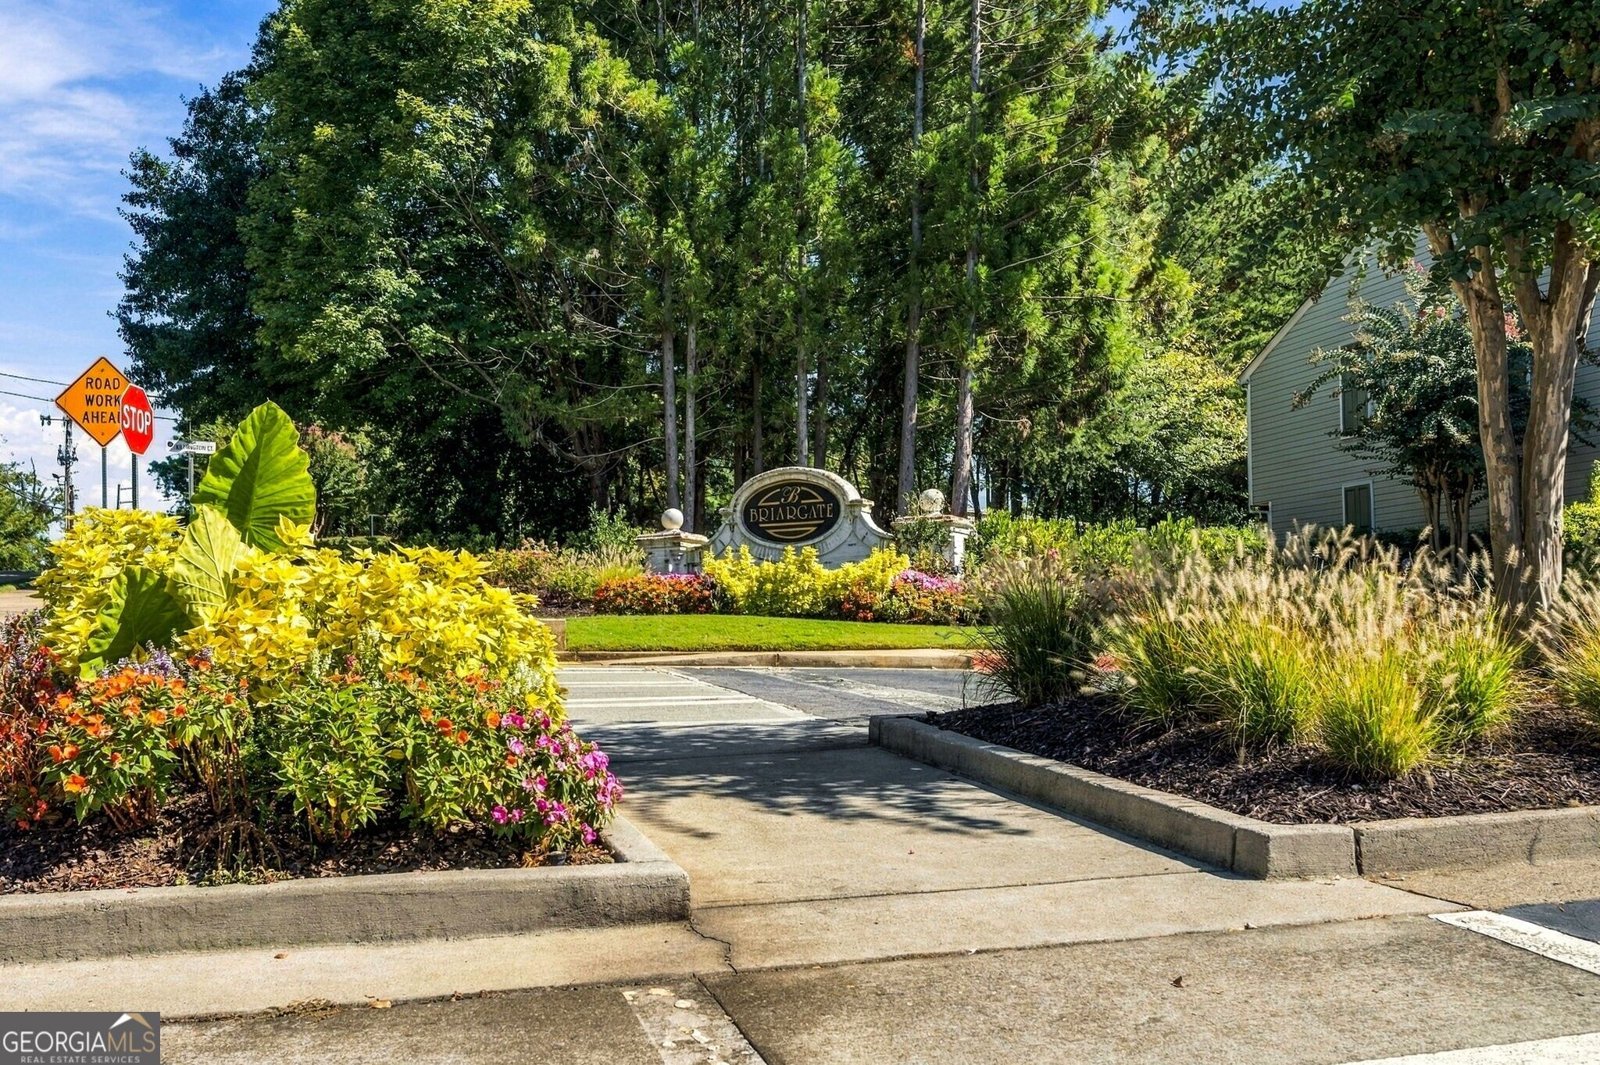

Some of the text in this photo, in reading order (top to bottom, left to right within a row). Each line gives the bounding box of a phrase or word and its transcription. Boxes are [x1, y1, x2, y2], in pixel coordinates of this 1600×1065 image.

[85, 377, 121, 390] ROAD
[85, 394, 121, 407] WORK
[122, 404, 152, 436] STOP
[781, 485, 801, 504] B
[750, 502, 834, 523] BRIARGATE
